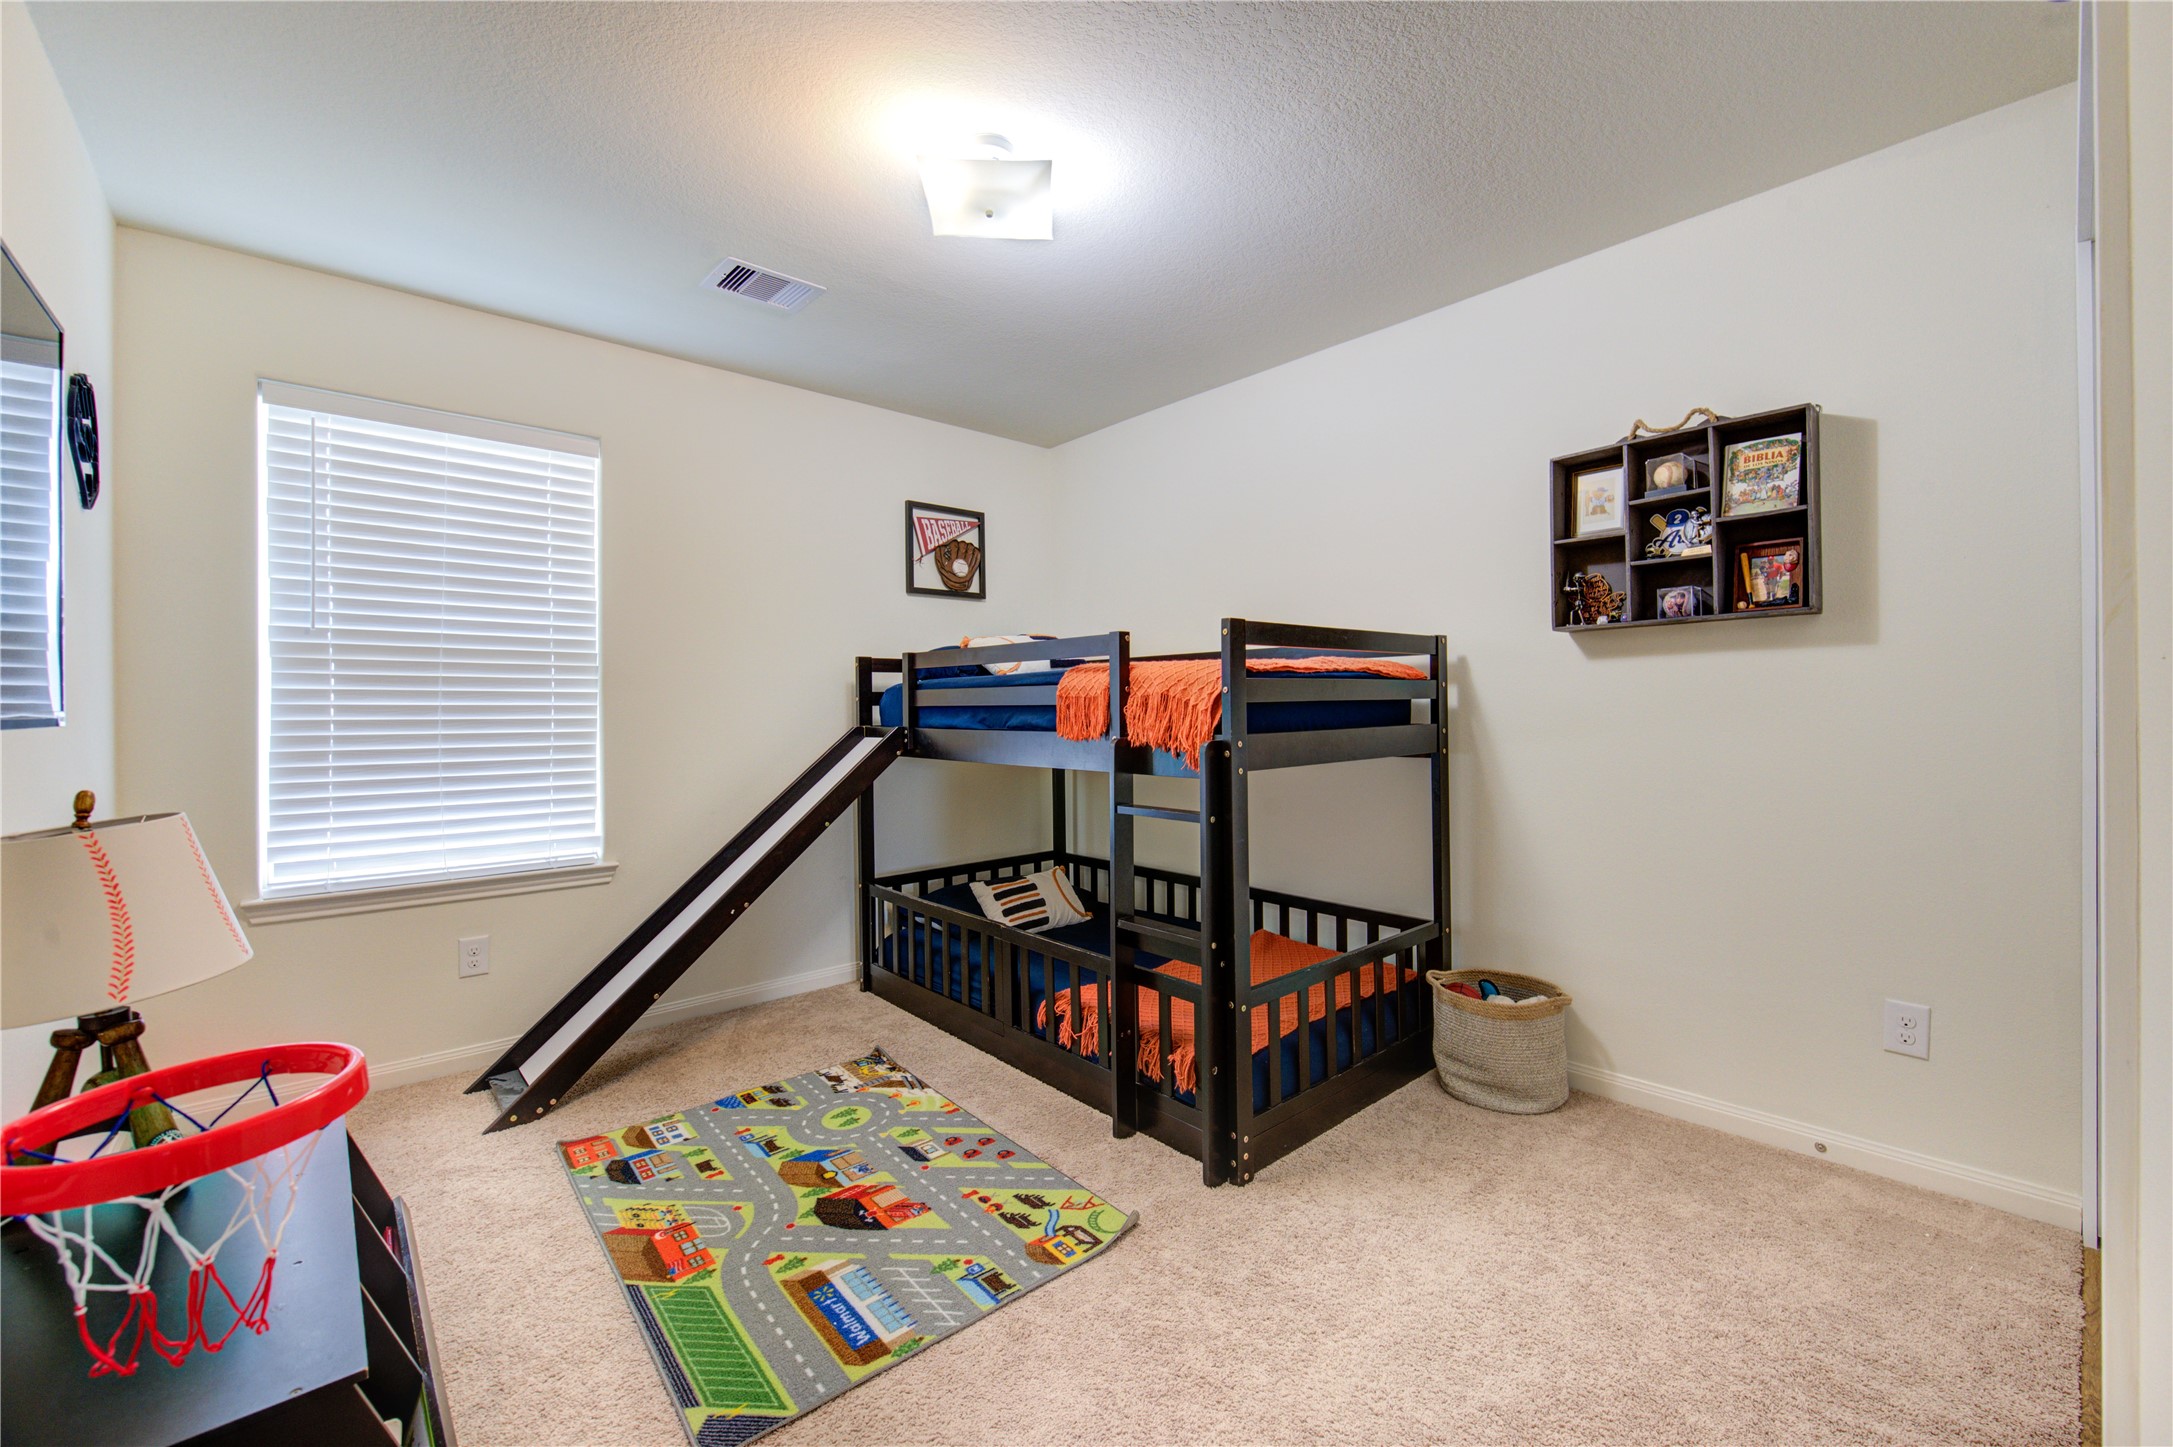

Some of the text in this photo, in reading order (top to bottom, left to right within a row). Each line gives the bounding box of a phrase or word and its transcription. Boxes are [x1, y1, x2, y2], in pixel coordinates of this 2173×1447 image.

[1743, 451, 1783, 464] BIBLIA
[1673, 513, 1682, 525] 2
[920, 518, 971, 550] BASEBALL
[821, 1297, 871, 1347] Walmart
